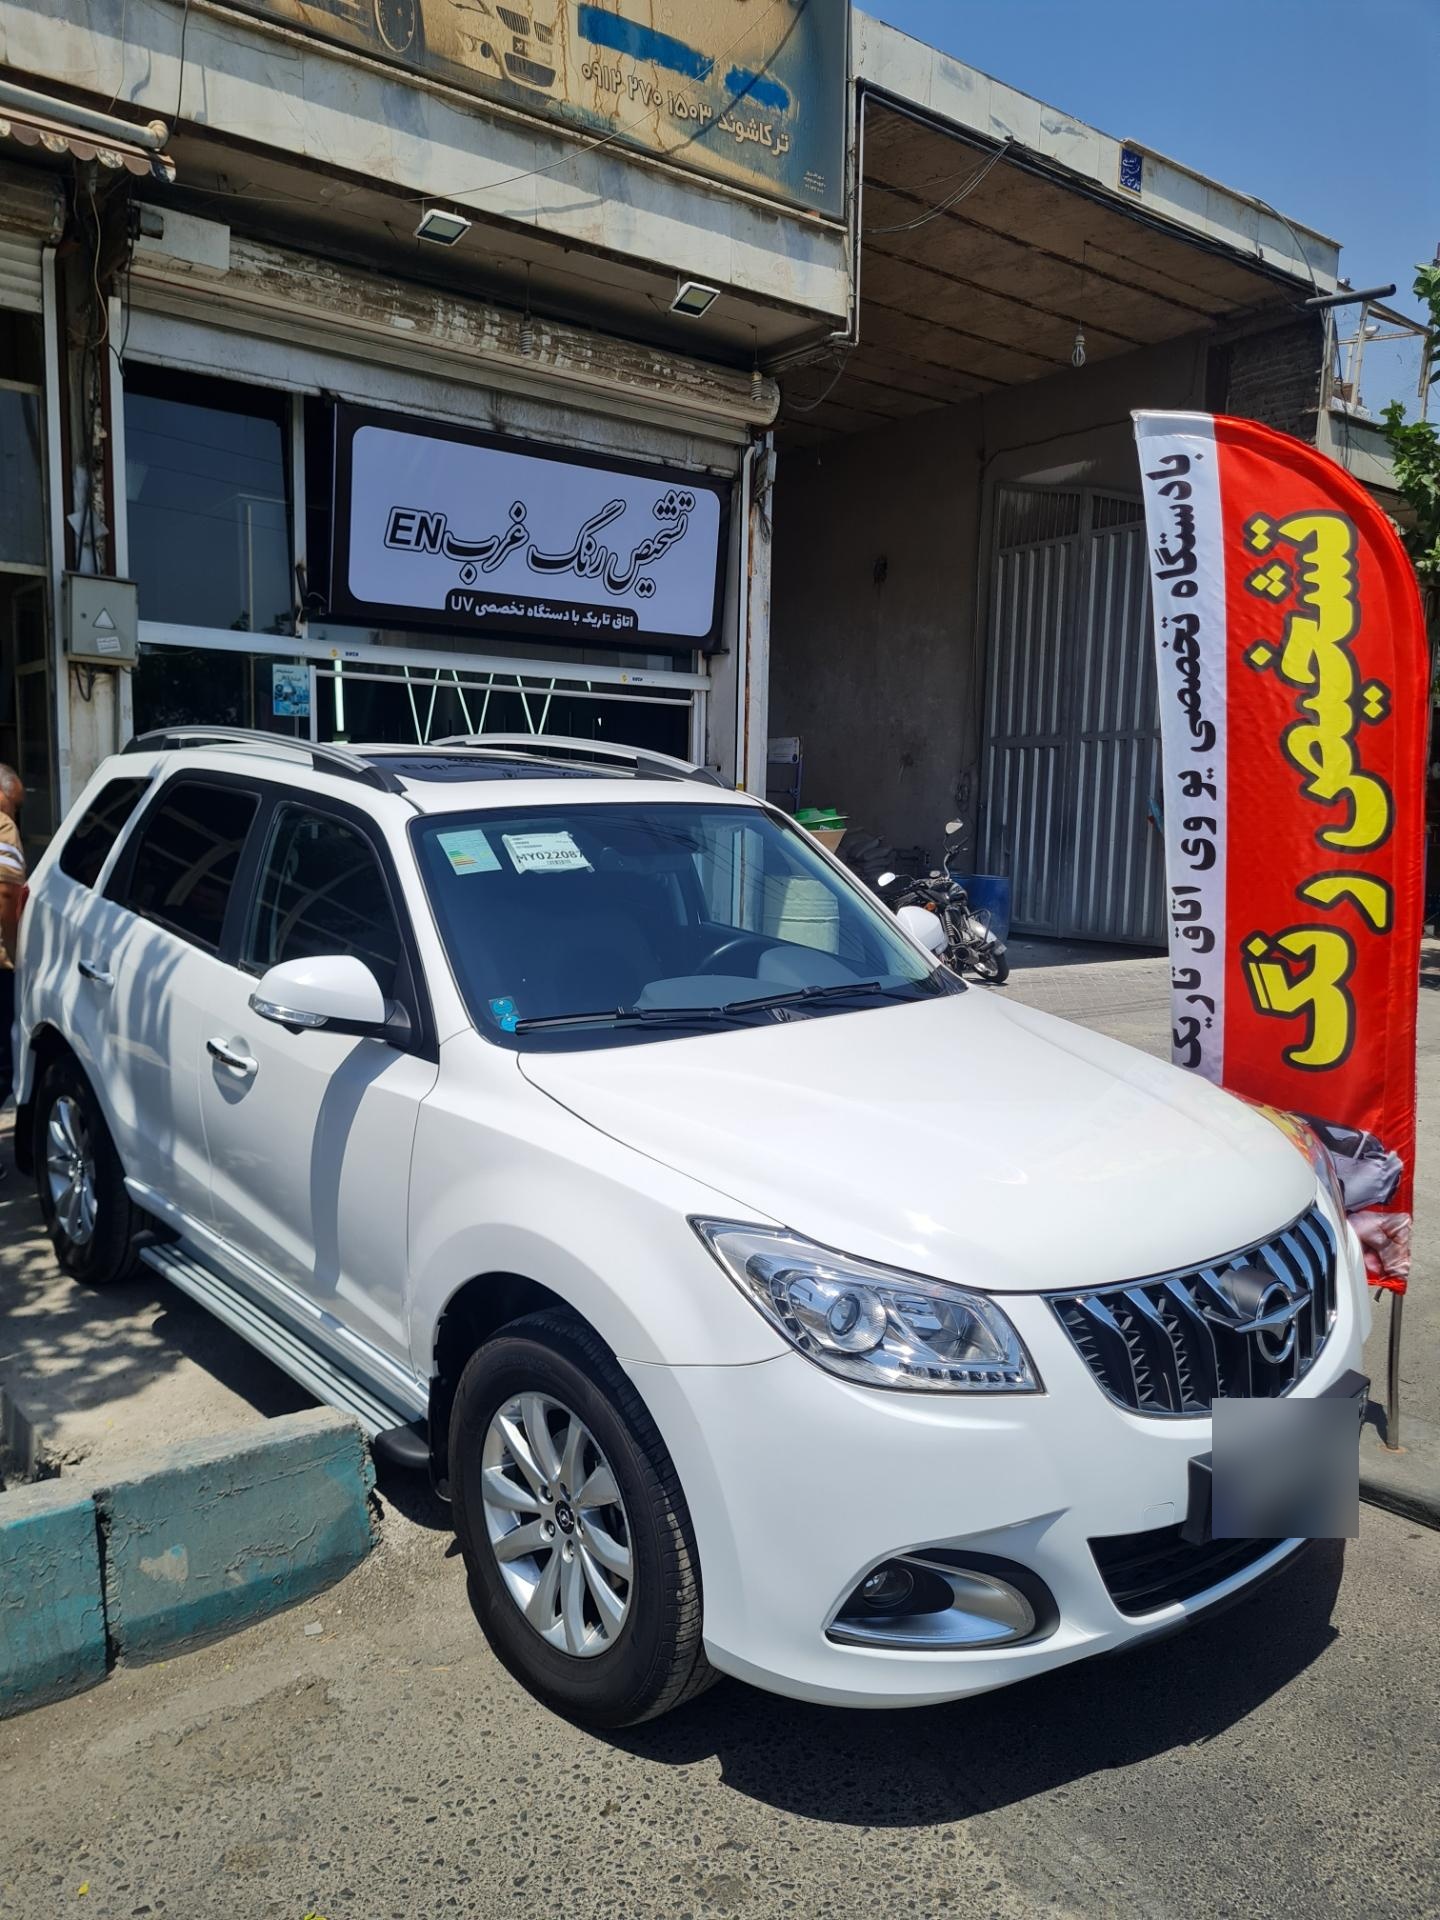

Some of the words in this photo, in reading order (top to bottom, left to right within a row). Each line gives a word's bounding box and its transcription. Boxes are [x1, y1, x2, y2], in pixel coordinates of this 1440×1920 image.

[582, 61, 622, 94] ۰۹۱۲
[627, 74, 663, 106] ۲۷۰
[667, 90, 713, 125] ۱۵۰۳
[383, 506, 447, 554] EN
[443, 500, 529, 585] غرب
[527, 498, 627, 579] رنگ
[604, 489, 696, 599] تشخیص
[450, 595, 474, 612] UV
[475, 601, 526, 617] تخصصی
[526, 603, 569, 621] دستگاه
[612, 615, 634, 630] اتاق
[1161, 613, 1217, 753] تخصصی
[1244, 511, 1392, 850] تشخیص
[1171, 885, 1216, 954] اتاق
[1242, 872, 1394, 1070] رنگ
[1171, 965, 1215, 1069] تاریک
